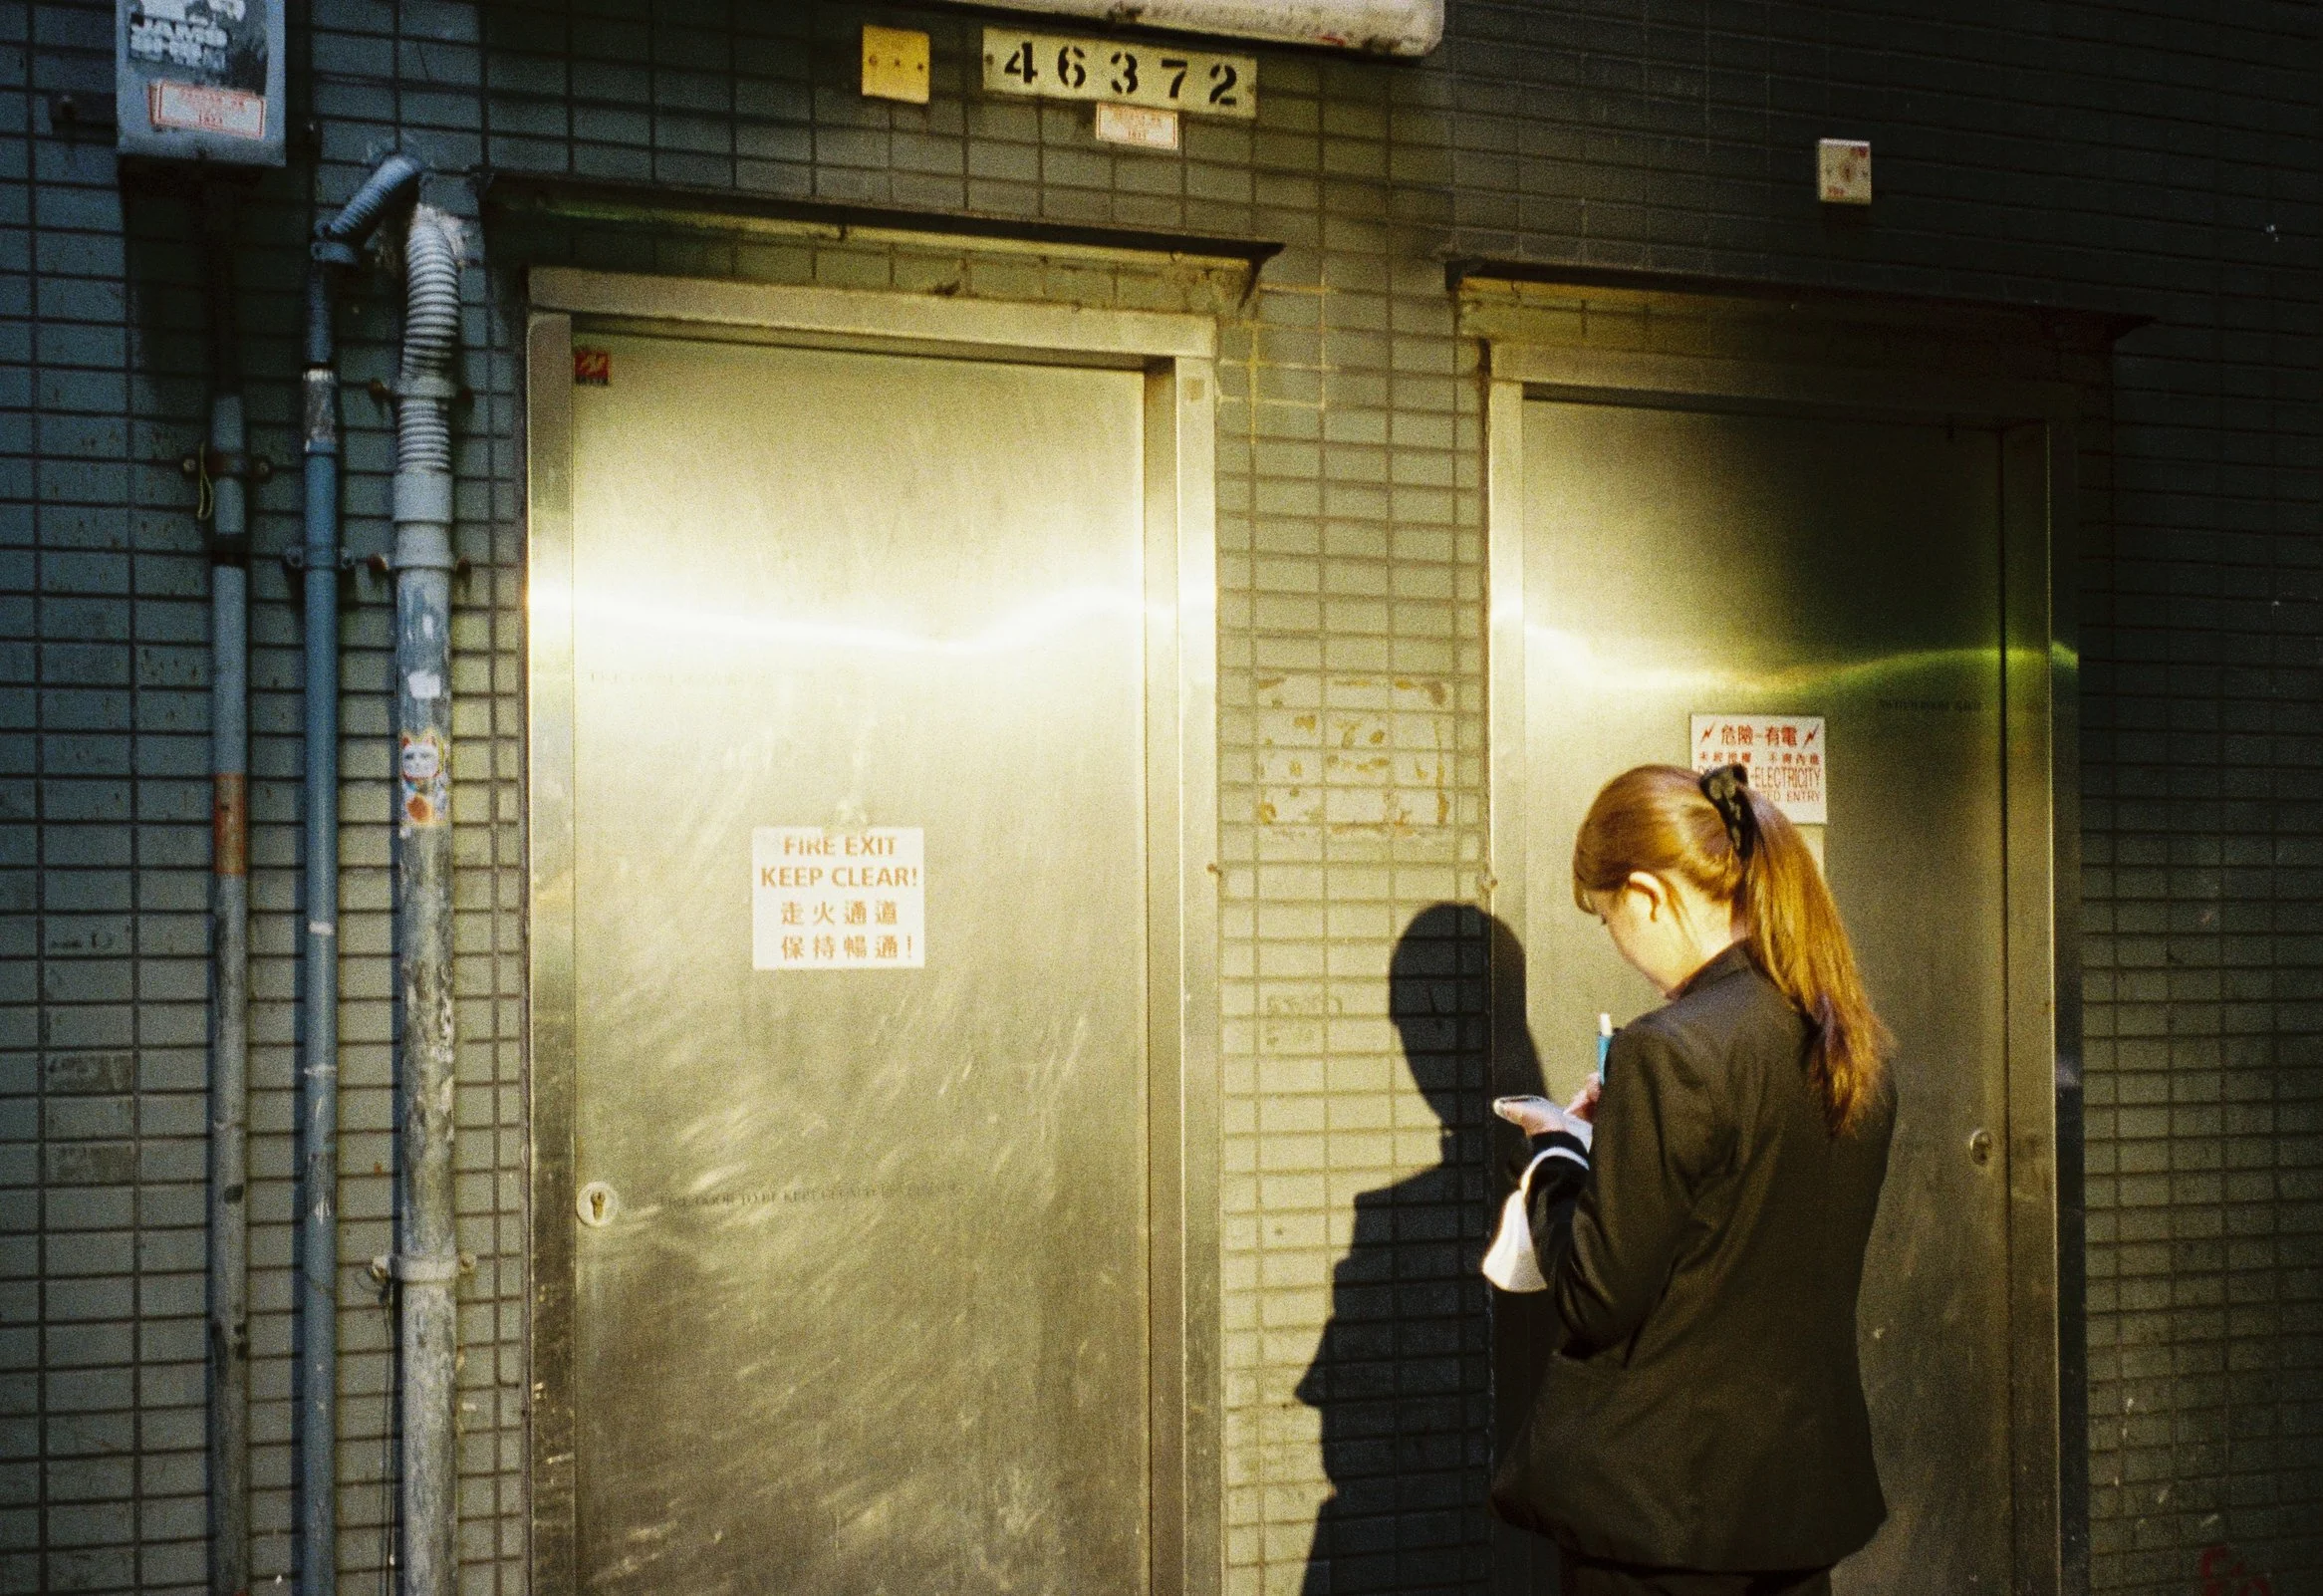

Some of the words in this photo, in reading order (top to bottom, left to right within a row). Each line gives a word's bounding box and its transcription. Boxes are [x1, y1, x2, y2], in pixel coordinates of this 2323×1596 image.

[1004, 41, 1237, 106] 46372
[1787, 790, 1820, 803] ENTRY
[784, 835, 836, 856] FIRE
[845, 835, 896, 856] EXIT
[761, 867, 823, 887] KEEP
[832, 867, 917, 887] CLEAR!
